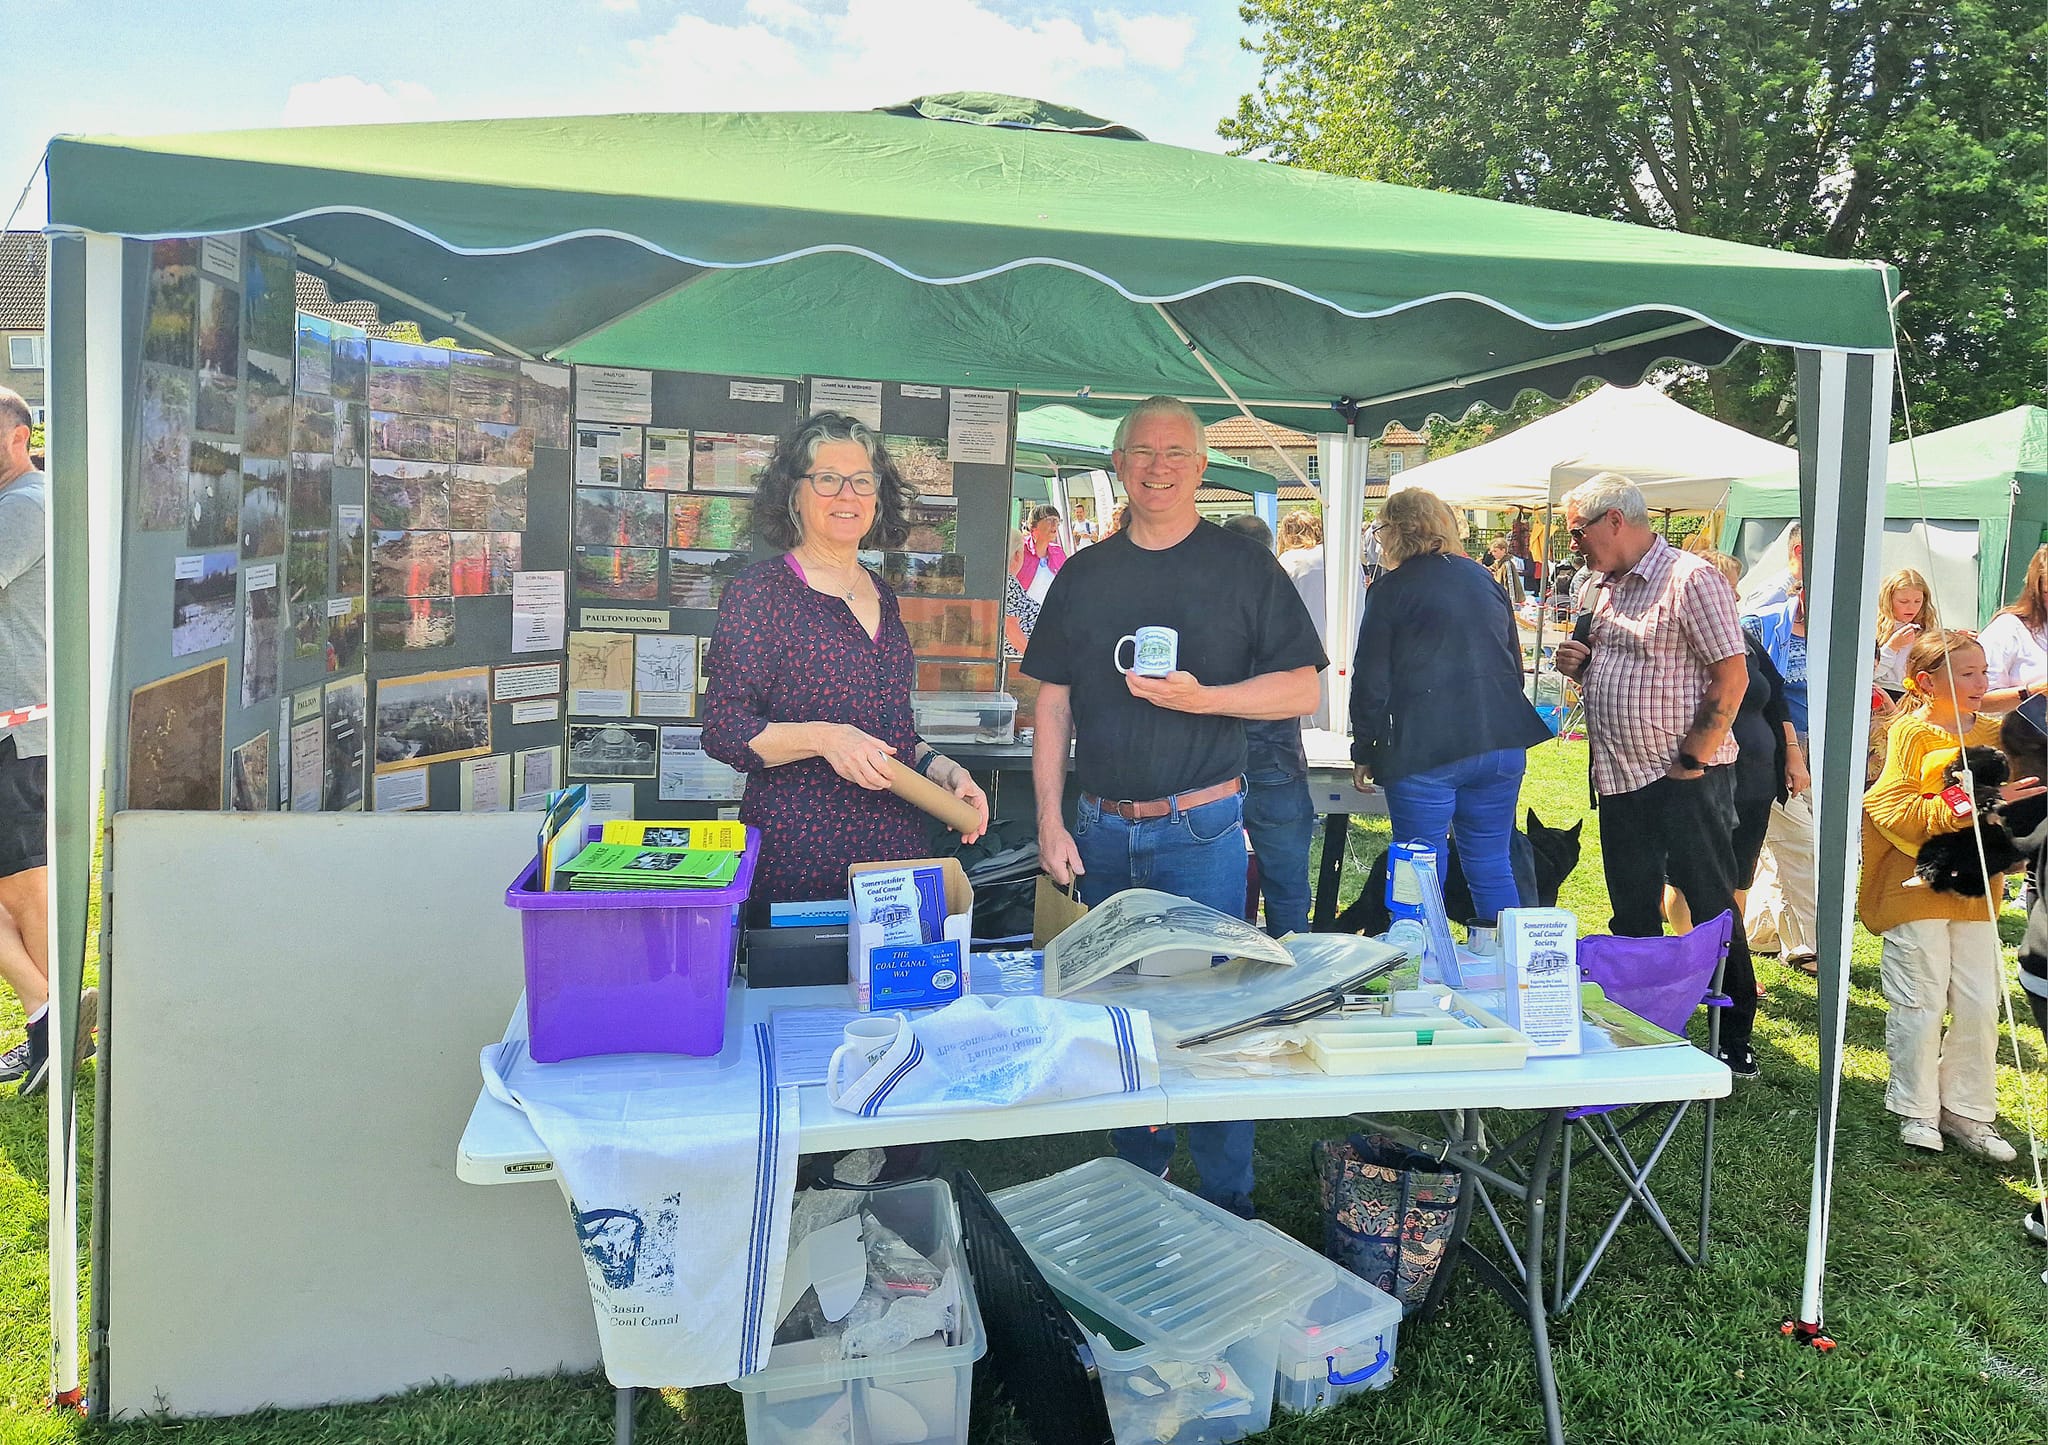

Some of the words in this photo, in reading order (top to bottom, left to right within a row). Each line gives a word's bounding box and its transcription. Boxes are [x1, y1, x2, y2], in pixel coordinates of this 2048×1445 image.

[586, 614, 624, 622] PAULTON
[625, 615, 663, 623] FOUNDRY
[860, 876, 906, 889] Somersetshire
[867, 887, 883, 896] Coal
[882, 883, 903, 894] Canal
[873, 894, 898, 904] Society
[1523, 921, 1568, 930] Somersetshire
[1528, 930, 1544, 938] Coal
[1544, 930, 1565, 938] Canal
[1534, 939, 1558, 948] Society
[892, 951, 910, 959] THE
[875, 962, 897, 971] COAL
[899, 959, 928, 968] CANAL
[893, 970, 910, 978] WAY
[611, 1303, 645, 1314] Basin
[610, 1317, 637, 1327] Coal
[641, 1313, 679, 1327] Canal
